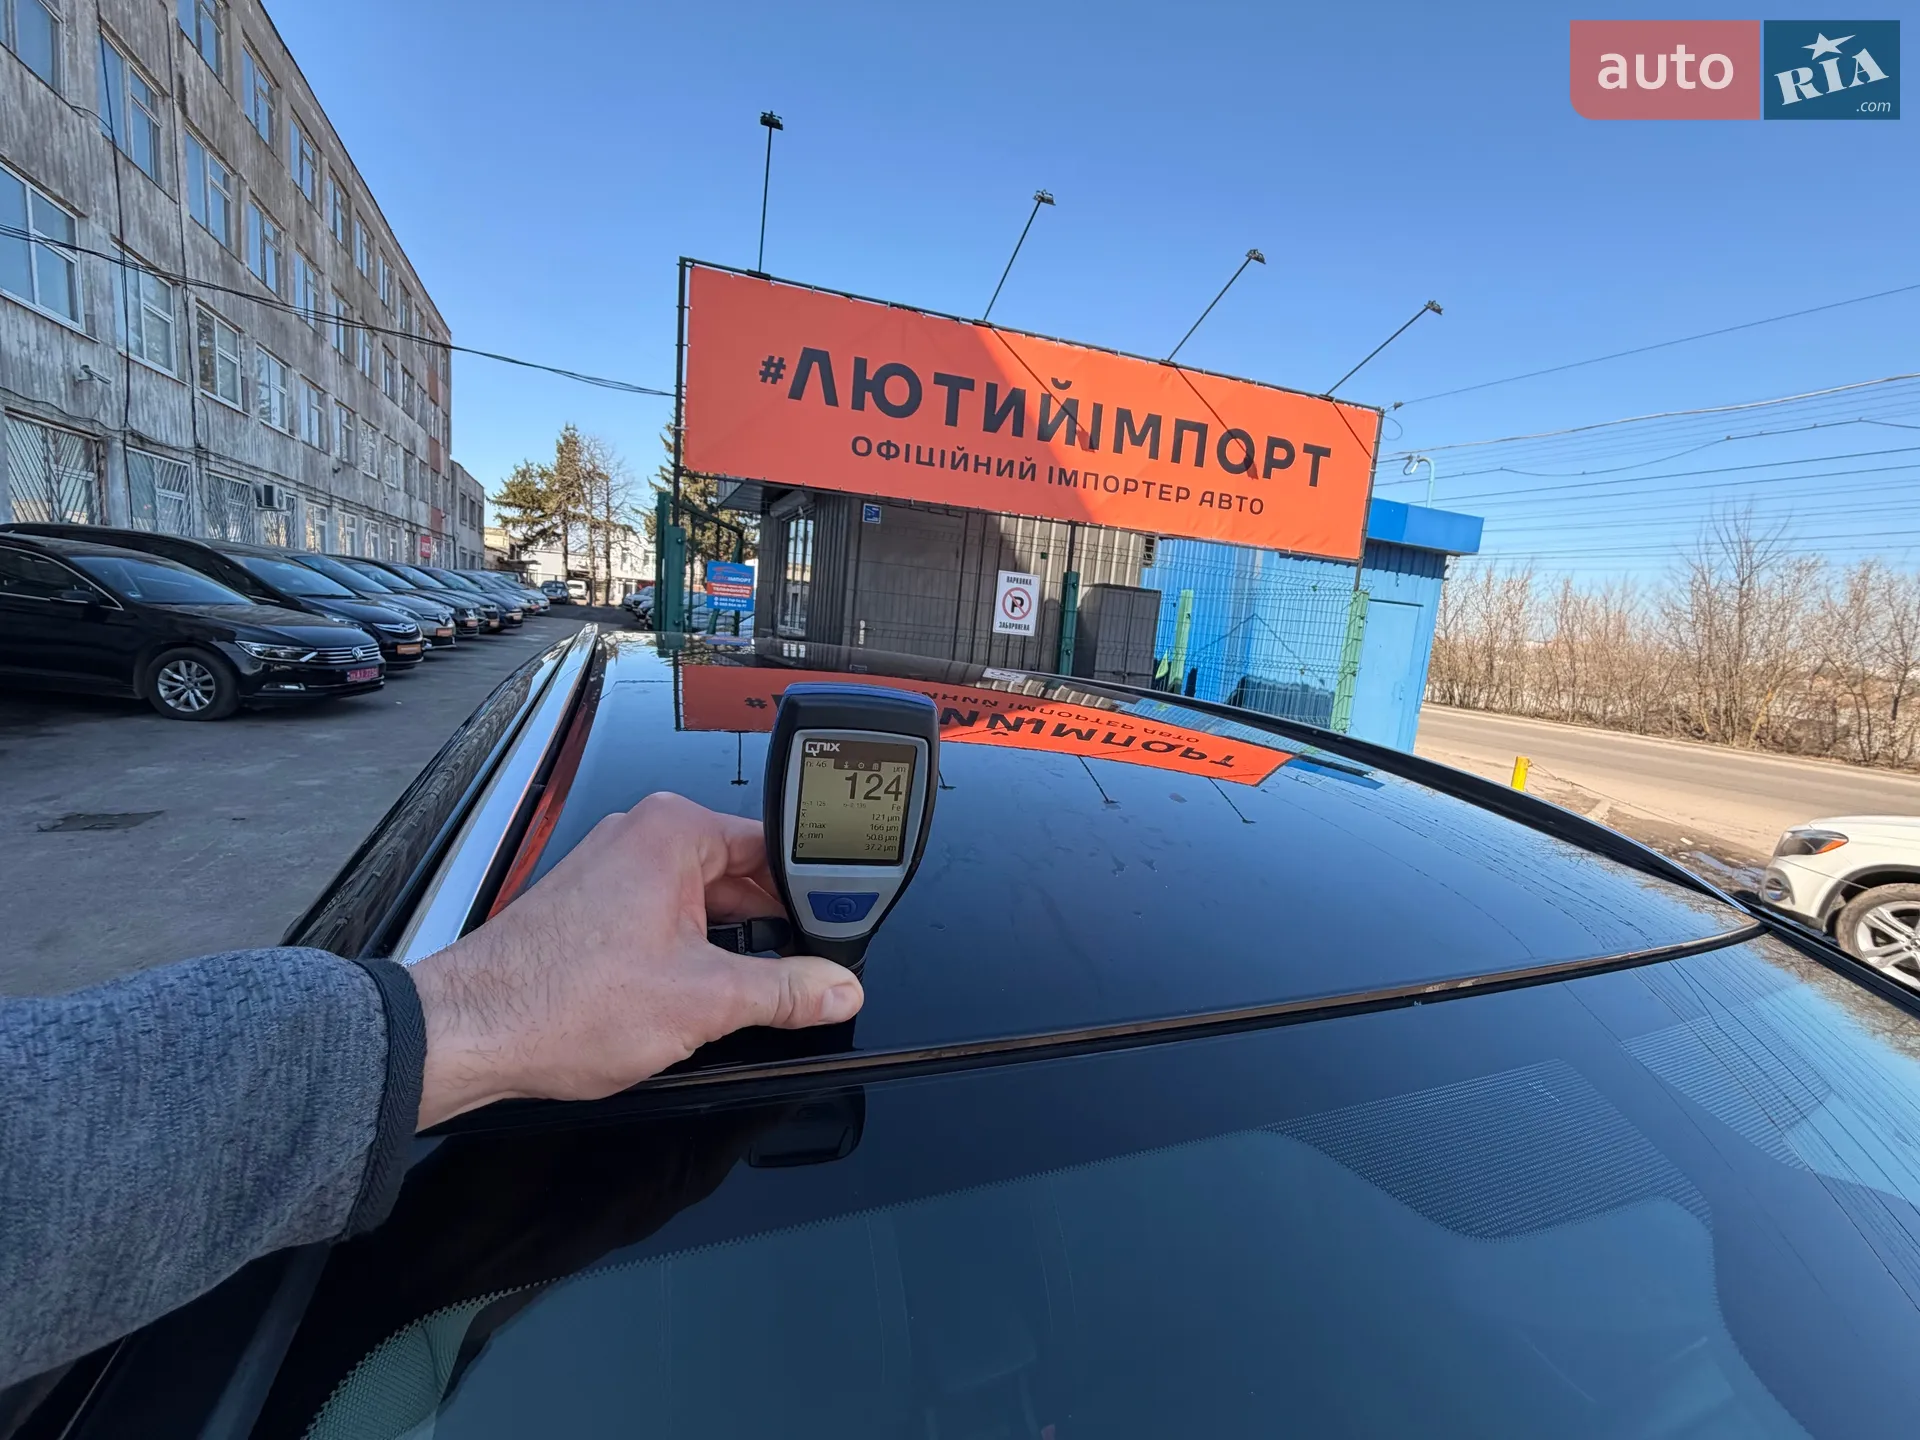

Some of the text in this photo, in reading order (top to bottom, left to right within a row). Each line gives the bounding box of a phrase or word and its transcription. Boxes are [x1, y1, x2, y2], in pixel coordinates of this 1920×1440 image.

[758, 346, 1332, 488] #ЛЮТИЙІМПОРТ
[851, 436, 1264, 515] ОФІЦІЙНИЙ ІМПОРТЕР АВТО
[844, 772, 903, 802] 124
[891, 803, 902, 811] Fe
[869, 823, 885, 831] 166
[866, 833, 884, 841] 50.8
[864, 843, 883, 851] 37.2
